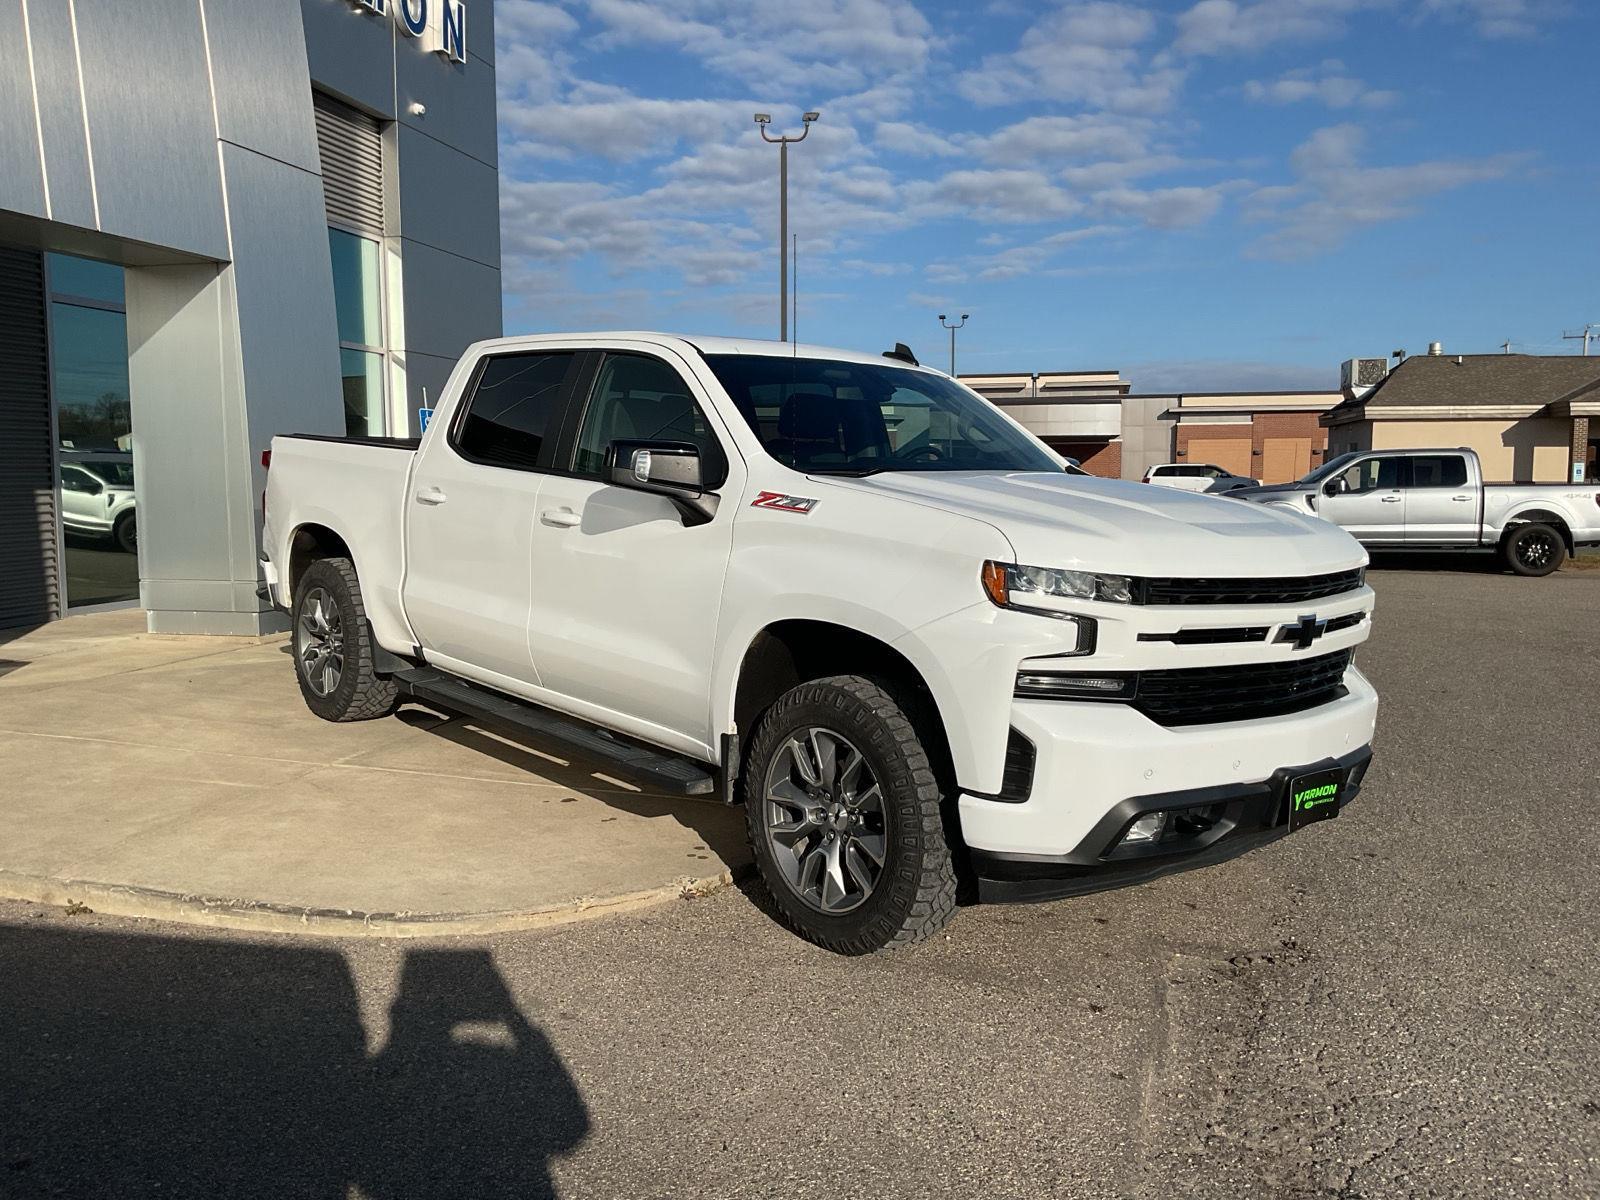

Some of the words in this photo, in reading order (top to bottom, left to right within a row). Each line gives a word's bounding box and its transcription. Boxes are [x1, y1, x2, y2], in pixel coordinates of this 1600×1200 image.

[361, 0, 466, 64] ON
[751, 490, 819, 514] Z71
[1295, 784, 1337, 811] YARMON
